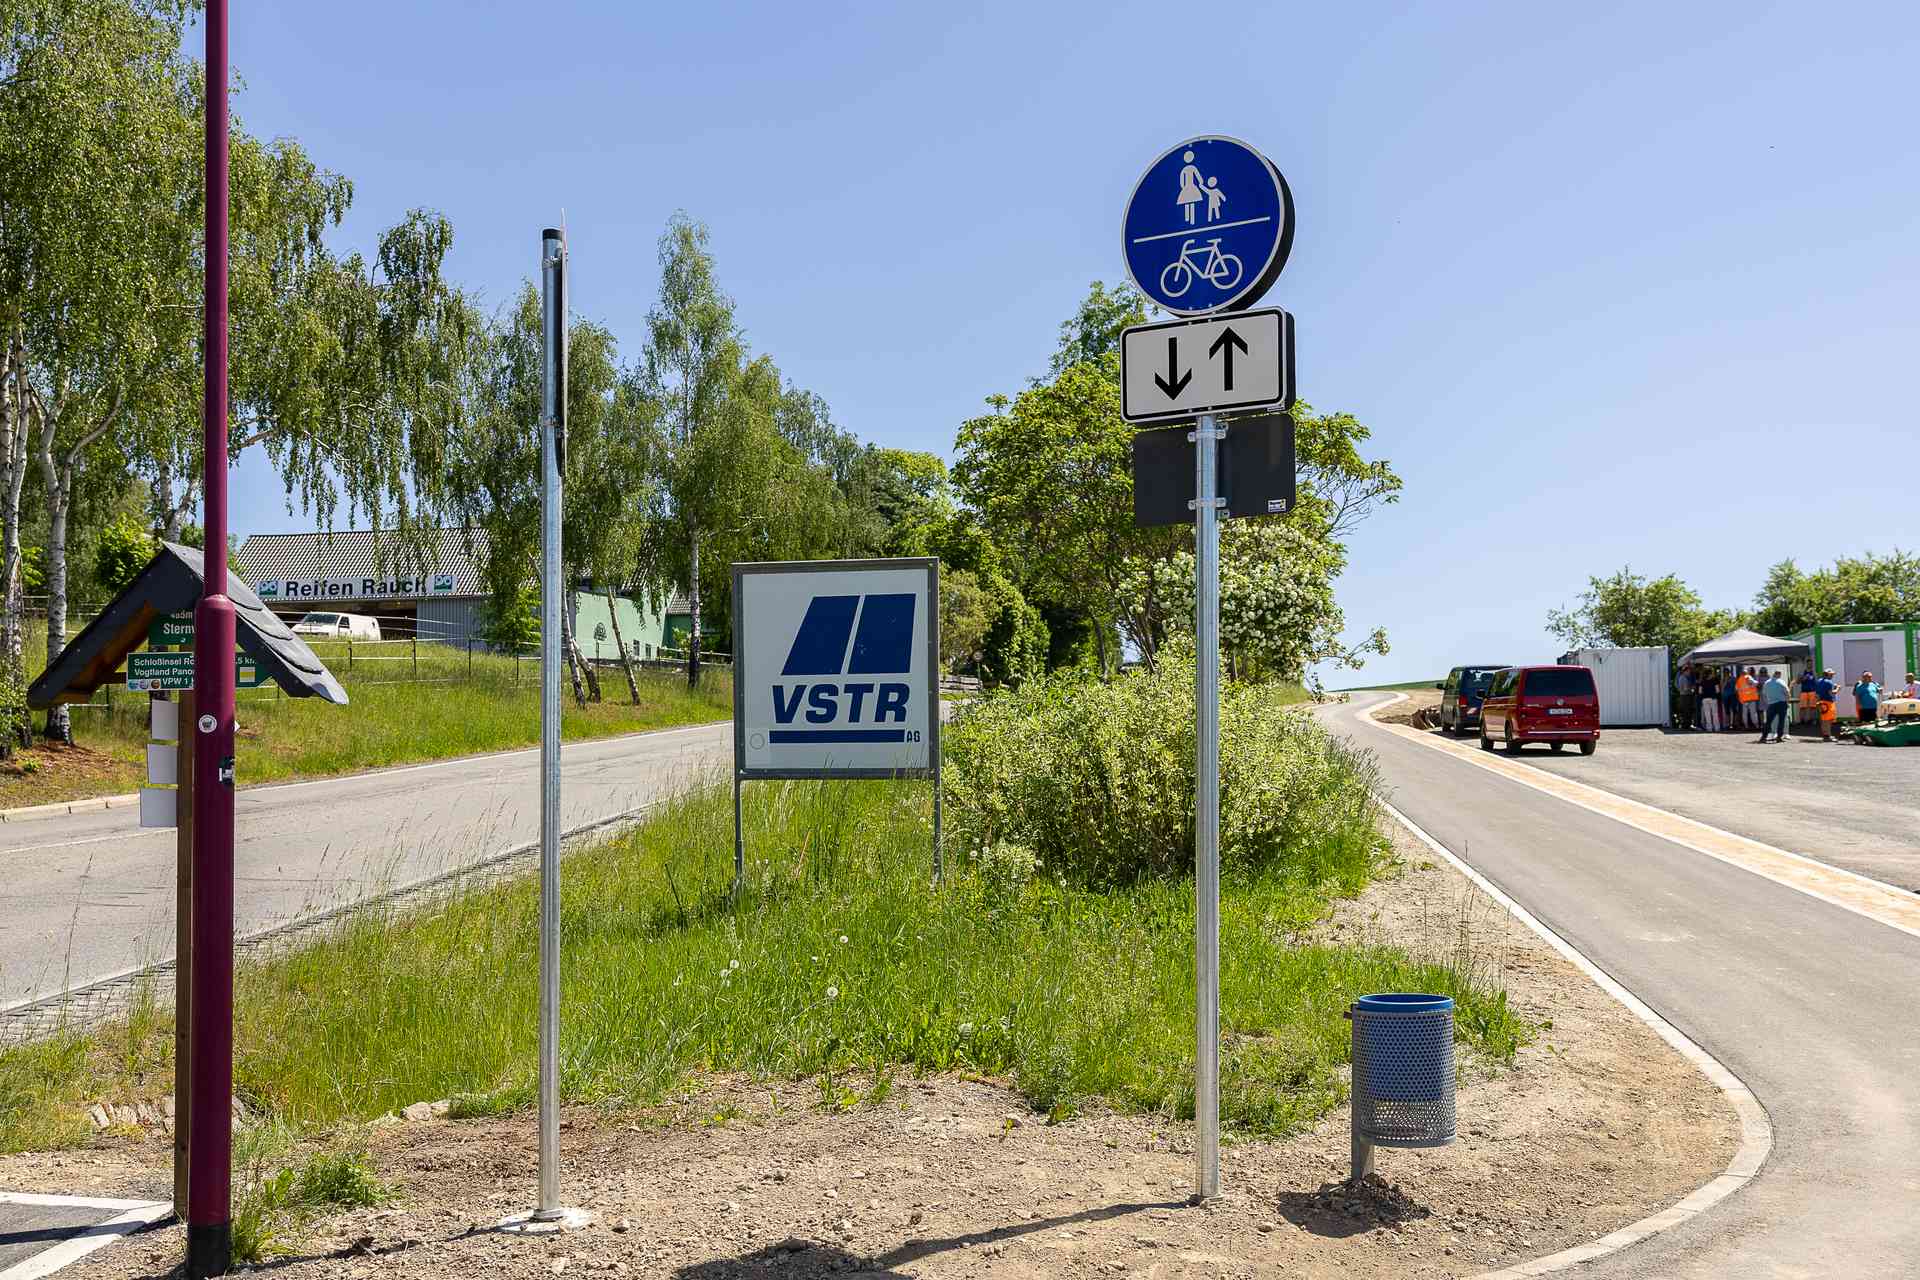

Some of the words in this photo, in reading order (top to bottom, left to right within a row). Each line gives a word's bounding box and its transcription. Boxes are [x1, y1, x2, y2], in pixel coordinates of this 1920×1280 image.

[285, 580, 353, 596] Reifen
[362, 576, 427, 595] Rauch
[134, 668, 170, 678] Vogtland
[172, 667, 195, 676] Pano
[162, 677, 182, 685] VPW
[772, 682, 911, 724] VSTR
[906, 730, 921, 743] AG
